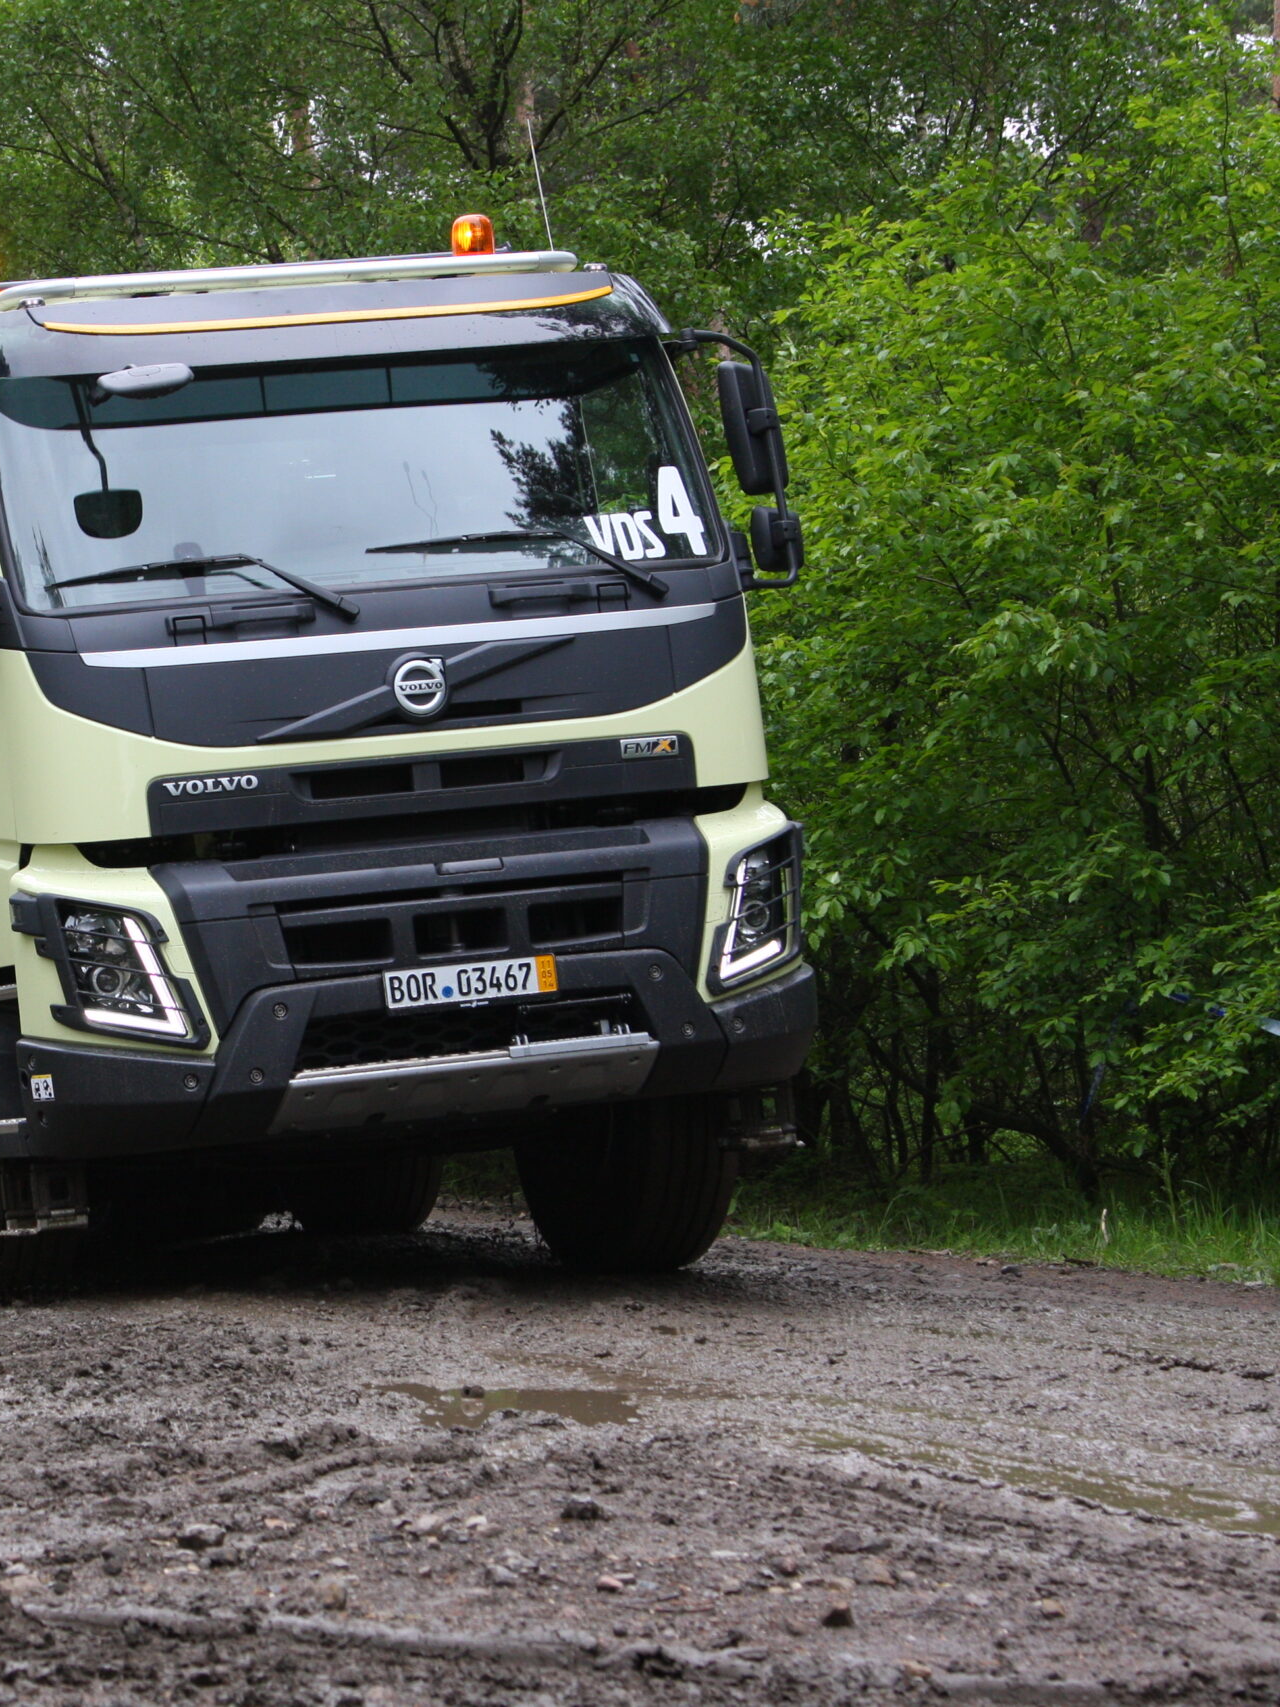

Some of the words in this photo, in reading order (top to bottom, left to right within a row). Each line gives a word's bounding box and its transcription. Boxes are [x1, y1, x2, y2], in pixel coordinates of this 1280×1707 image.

[582, 510, 666, 561] VDS
[398, 681, 443, 692] VOLVO
[623, 738, 676, 755] FMX
[162, 774, 259, 797] VOLVO
[388, 972, 438, 1004] BOR
[456, 962, 532, 997] 03467
